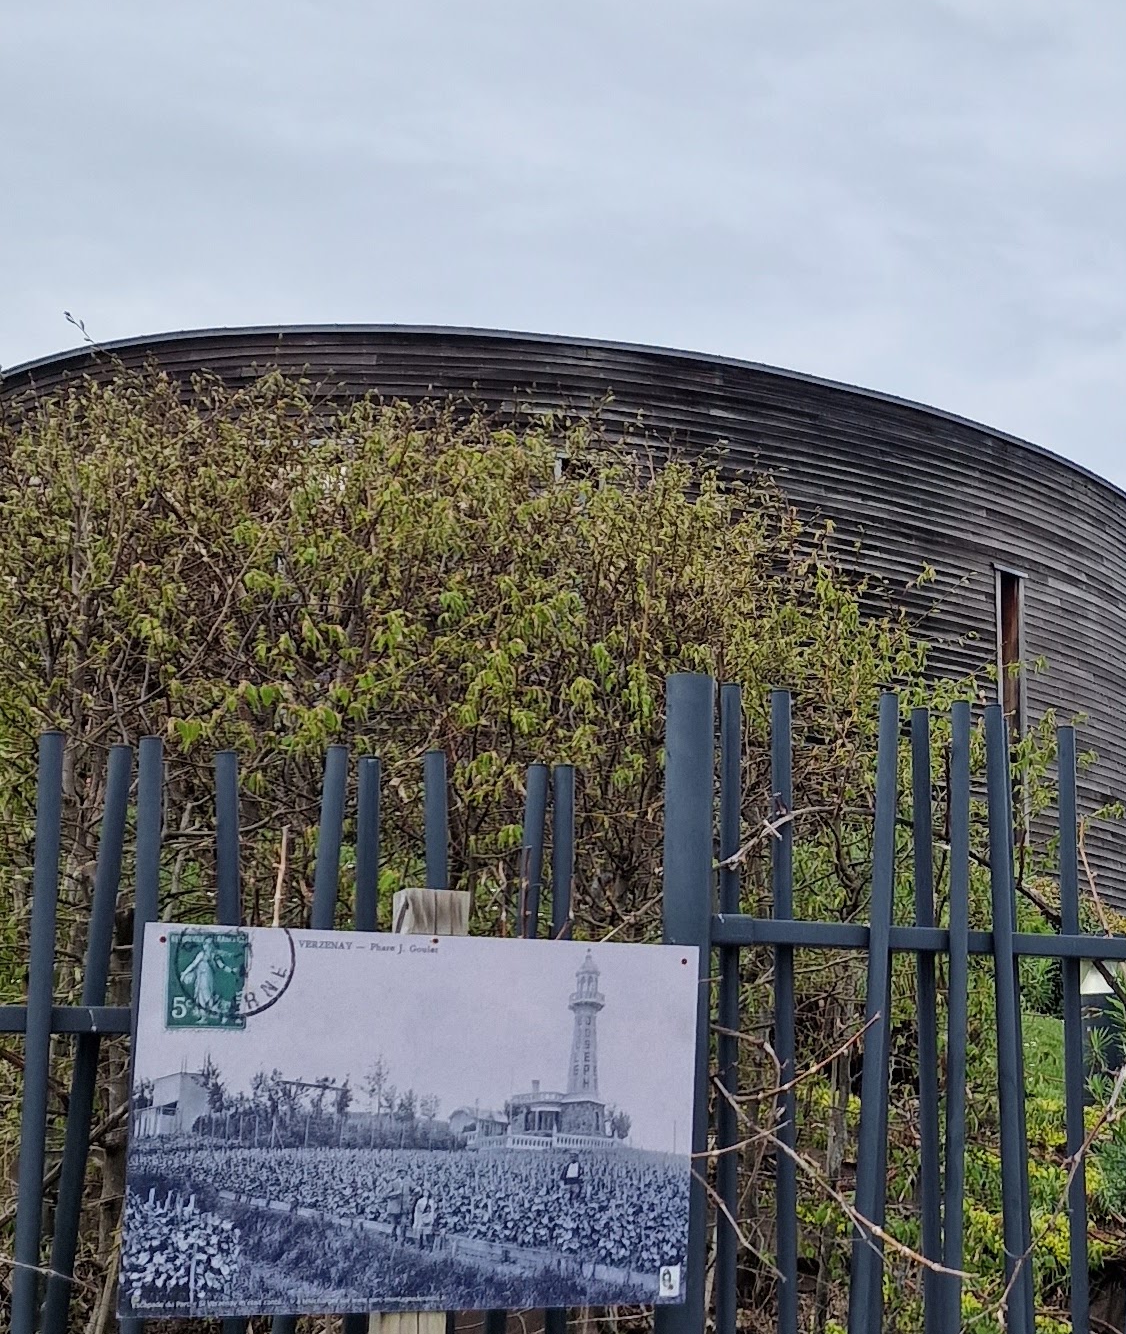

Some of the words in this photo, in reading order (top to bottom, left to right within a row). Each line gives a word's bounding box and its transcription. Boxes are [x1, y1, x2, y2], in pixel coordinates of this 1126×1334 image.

[299, 940, 353, 950] VERZENAY
[370, 942, 395, 952] Phare
[398, 944, 405, 954] J.
[583, 1015, 592, 1088] JOSEPH
